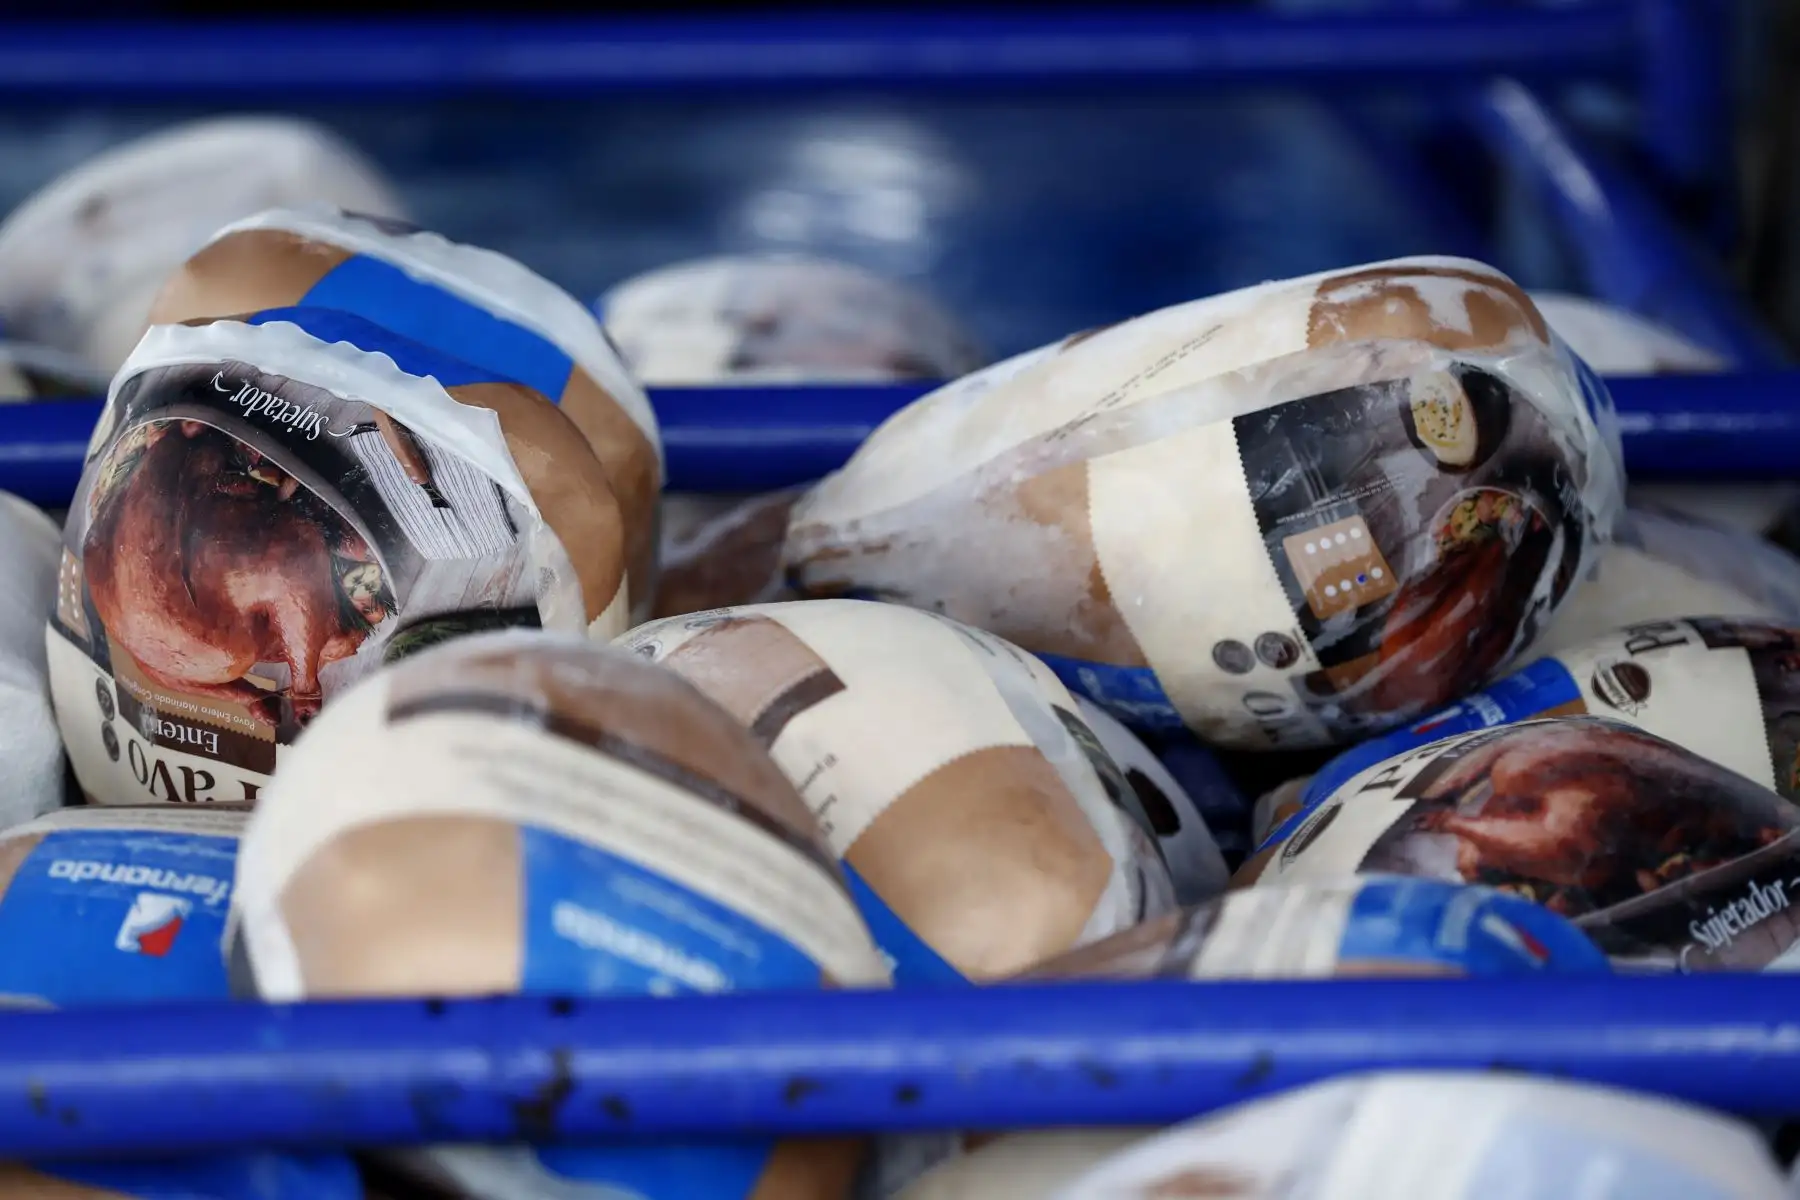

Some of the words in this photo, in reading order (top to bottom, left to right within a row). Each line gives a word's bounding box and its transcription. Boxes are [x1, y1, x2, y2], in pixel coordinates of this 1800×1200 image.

[229, 379, 330, 441] Sujetador
[154, 694, 199, 713] Marinado
[200, 706, 232, 724] Entero
[233, 716, 256, 731] Pavo
[143, 714, 220, 756] Enter
[48, 859, 230, 906] fernando
[1688, 878, 1791, 956] Sujetador
